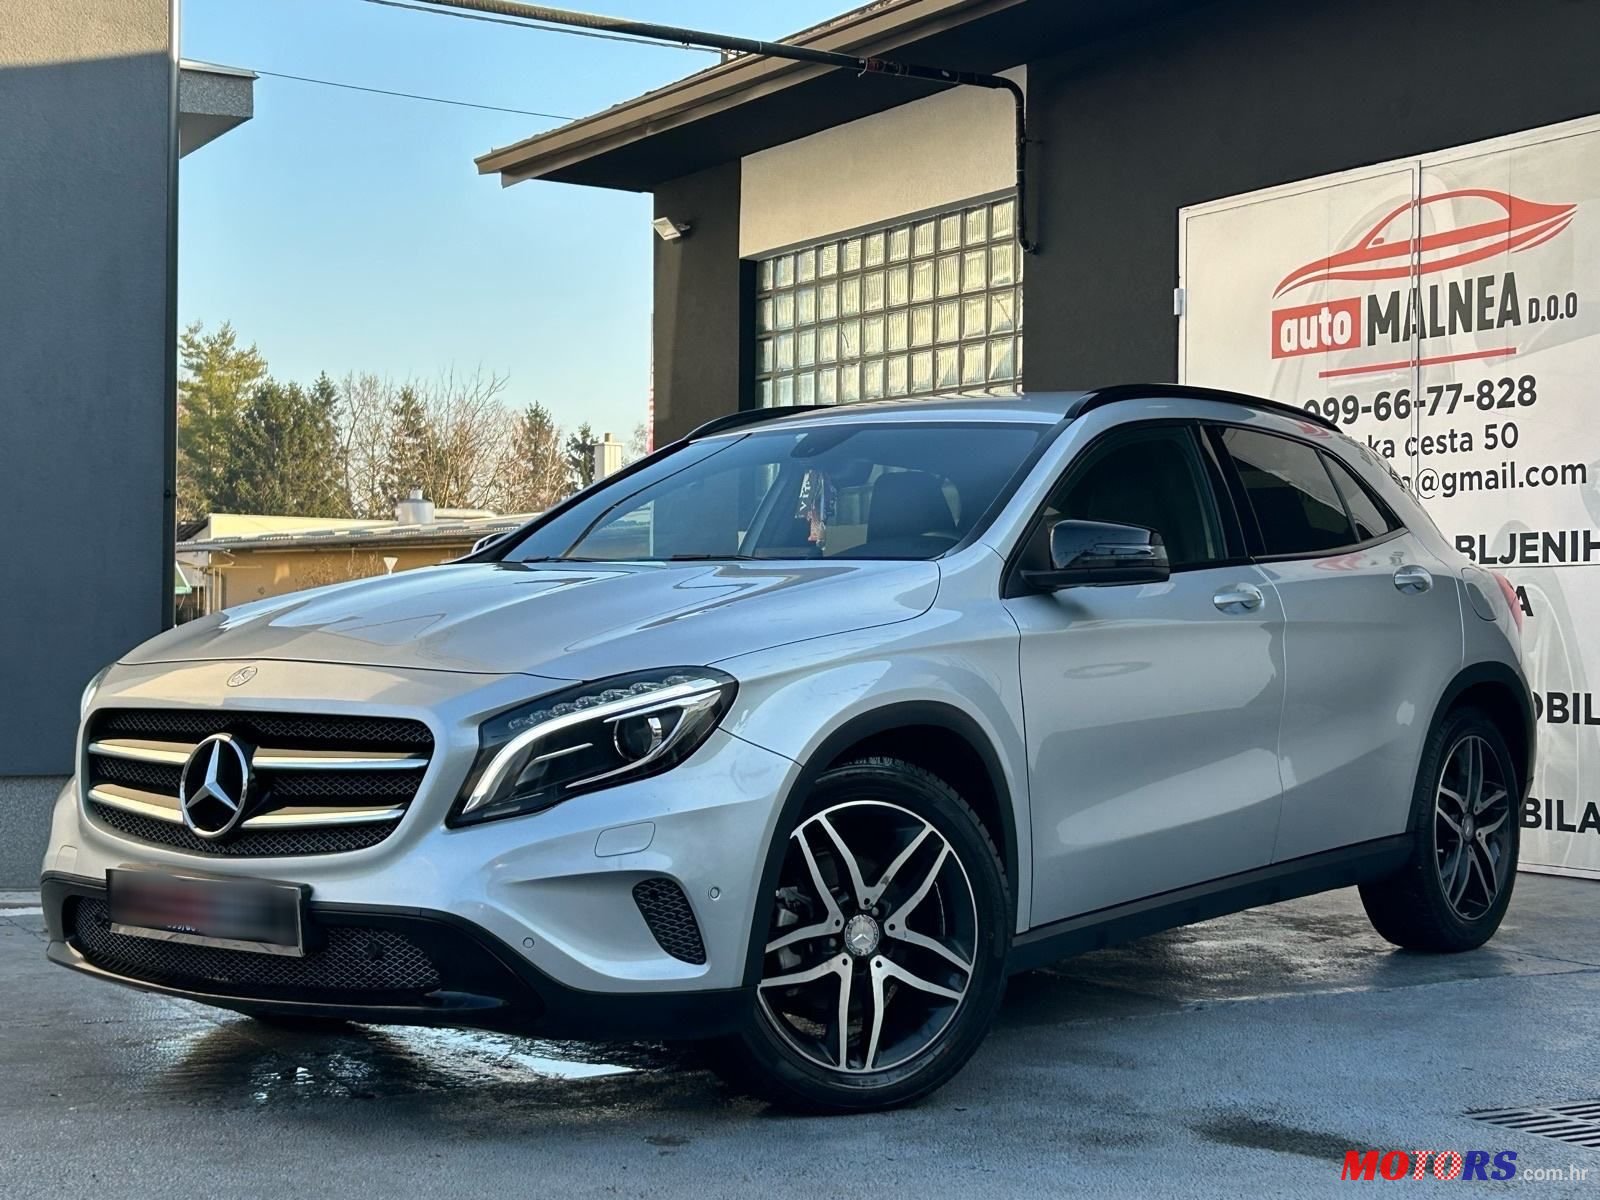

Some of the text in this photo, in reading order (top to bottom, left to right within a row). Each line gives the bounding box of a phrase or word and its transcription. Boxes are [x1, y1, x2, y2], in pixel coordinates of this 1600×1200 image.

[1280, 272, 1578, 353] auto MALNEA D.O.O
[1361, 422, 1519, 459] ka cesta 50
